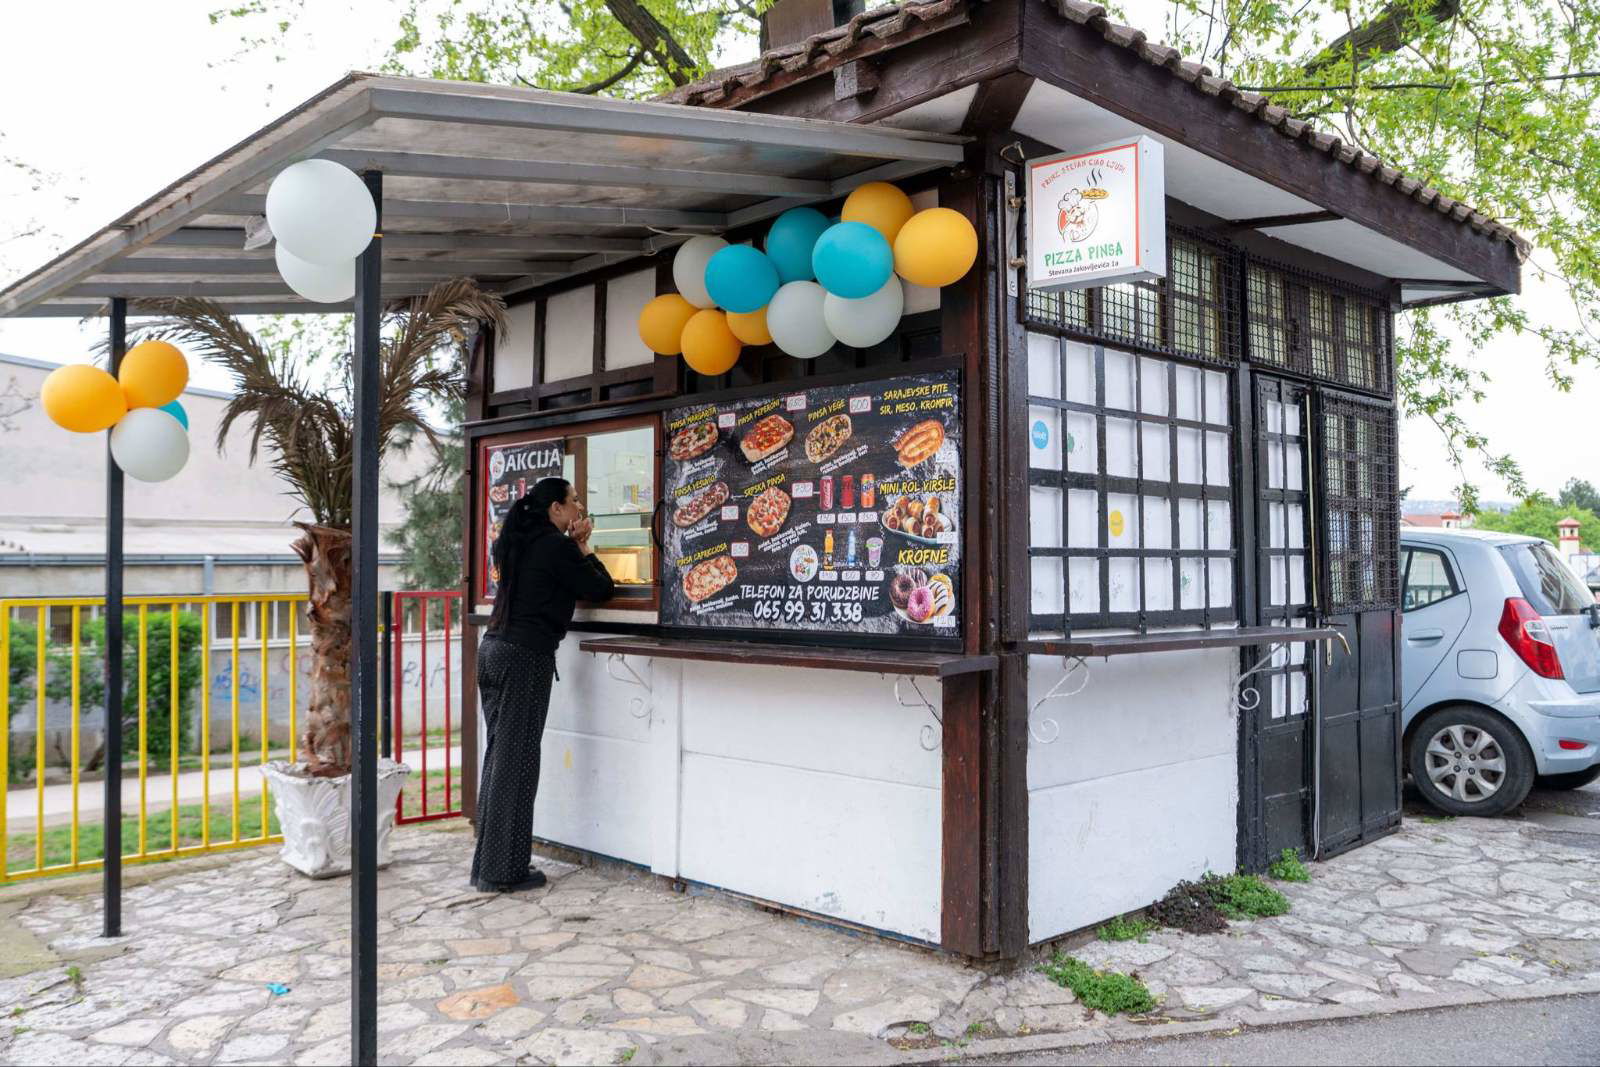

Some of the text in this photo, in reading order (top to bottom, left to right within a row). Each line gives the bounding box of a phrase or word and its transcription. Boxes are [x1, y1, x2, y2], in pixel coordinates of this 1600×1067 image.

[1044, 241, 1123, 266] PIZZA PINSA
[883, 383, 949, 400] SARAJEVSKE PITE
[807, 399, 846, 423] PINSA VEGE
[920, 397, 954, 410] KROMPIR
[505, 448, 561, 472] AKCIJA
[880, 482, 899, 495] MINI
[902, 480, 920, 493] ROL
[898, 549, 948, 565] KROFNE
[740, 585, 880, 601] TELEFON ZA PORUDZBINE
[753, 600, 781, 620] 065
[784, 600, 805, 621] 99
[809, 601, 827, 620] 31
[830, 601, 863, 622] 338
